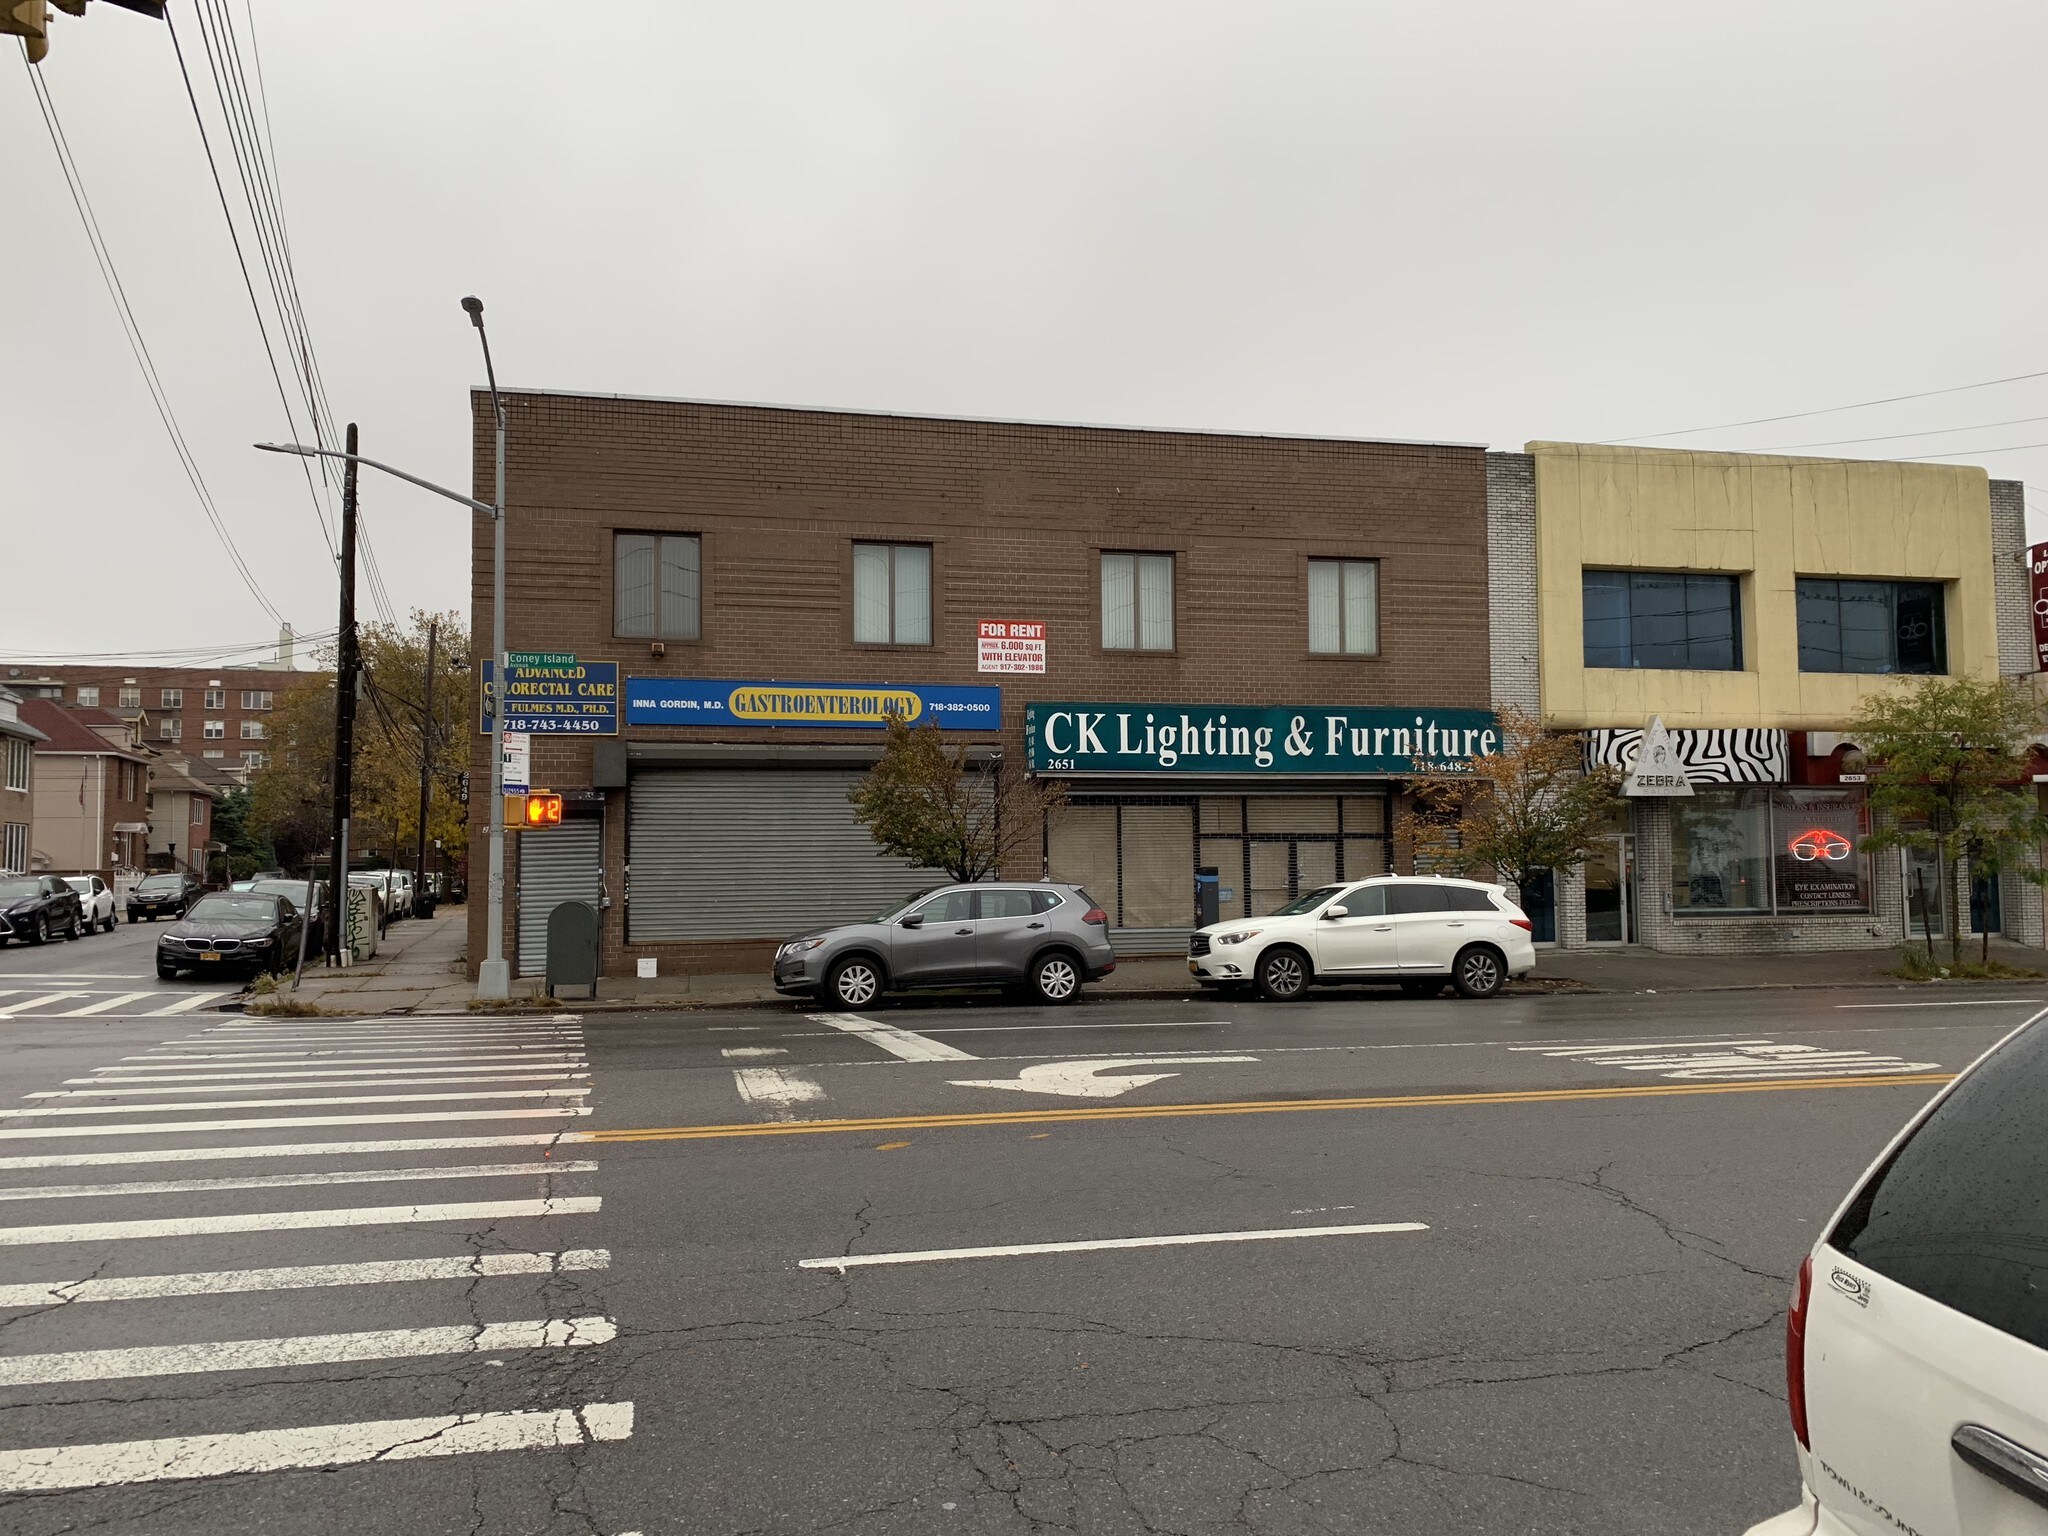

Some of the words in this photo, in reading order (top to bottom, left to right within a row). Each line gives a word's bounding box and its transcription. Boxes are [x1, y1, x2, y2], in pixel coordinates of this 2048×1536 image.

[980, 623, 1006, 636] FOR
[1010, 624, 1042, 637] RENT
[510, 654, 540, 665] Coney
[544, 655, 574, 664] Island
[982, 652, 1002, 660] WITH
[1005, 653, 1043, 661] ELEVATOR
[515, 667, 586, 679] ADVANCED
[484, 682, 573, 696] CLORECTAL
[578, 684, 615, 696] CARE
[512, 704, 553, 713] FULMES
[583, 705, 609, 713] PH.D.
[633, 700, 656, 708] INNA
[660, 700, 700, 710] GORDIN,
[704, 701, 724, 709] M.D.
[735, 694, 916, 716] GASTROENTEROLOGY
[929, 703, 990, 712] 718-382-0500
[504, 720, 599, 730] 718-743-4450
[1045, 712, 1108, 754] CK
[1116, 713, 1274, 768] Lighting
[1284, 716, 1314, 756] &
[1325, 716, 1496, 757] Furniture
[1048, 759, 1074, 769] 2651
[461, 772, 470, 800] 2649
[1637, 775, 1686, 787] ZEBRA
[548, 800, 558, 819] 12
